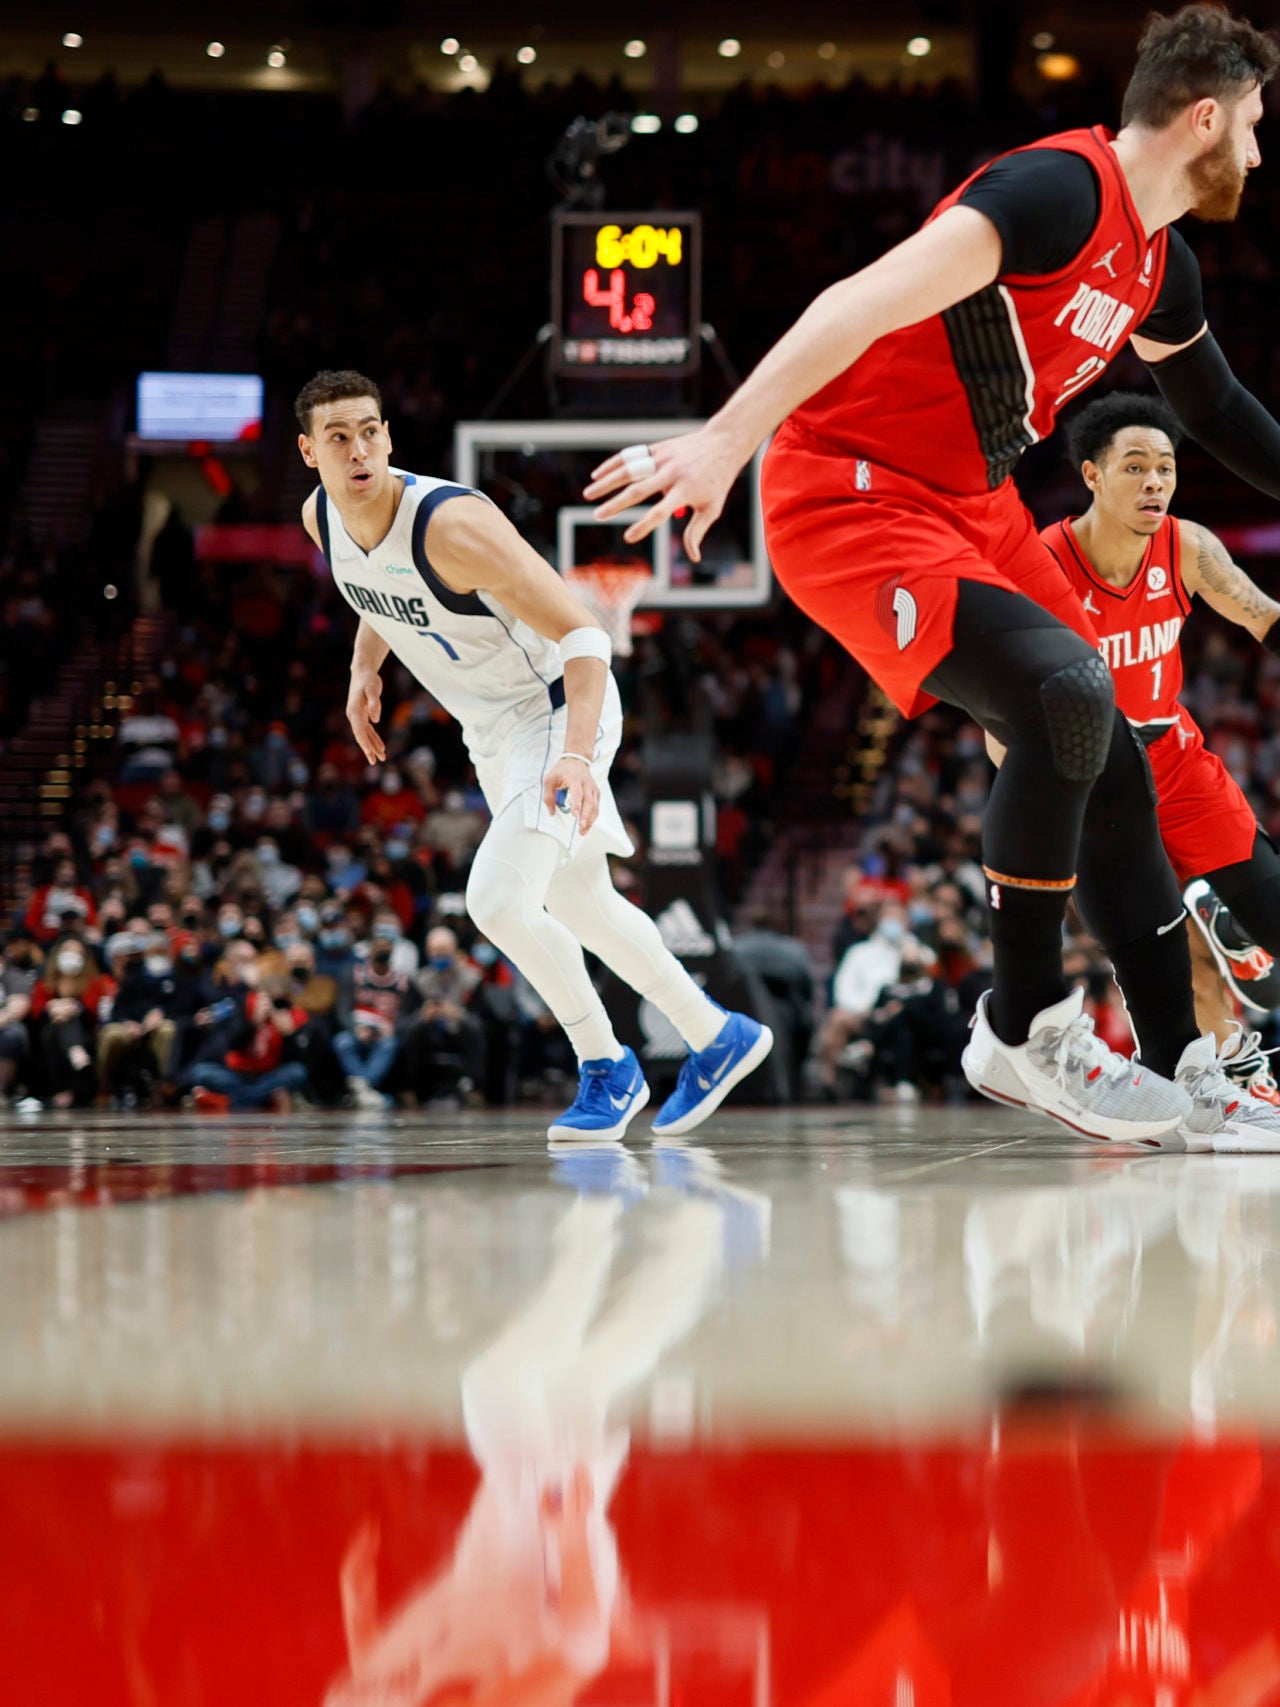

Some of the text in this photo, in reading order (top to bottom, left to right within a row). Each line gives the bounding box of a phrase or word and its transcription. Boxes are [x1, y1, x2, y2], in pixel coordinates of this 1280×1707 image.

[595, 225, 682, 269] 6:04
[343, 581, 430, 627] DALLAS
[415, 629, 460, 661] 7
[1097, 616, 1181, 669] RTLAND
[1151, 660, 1162, 701] 1
